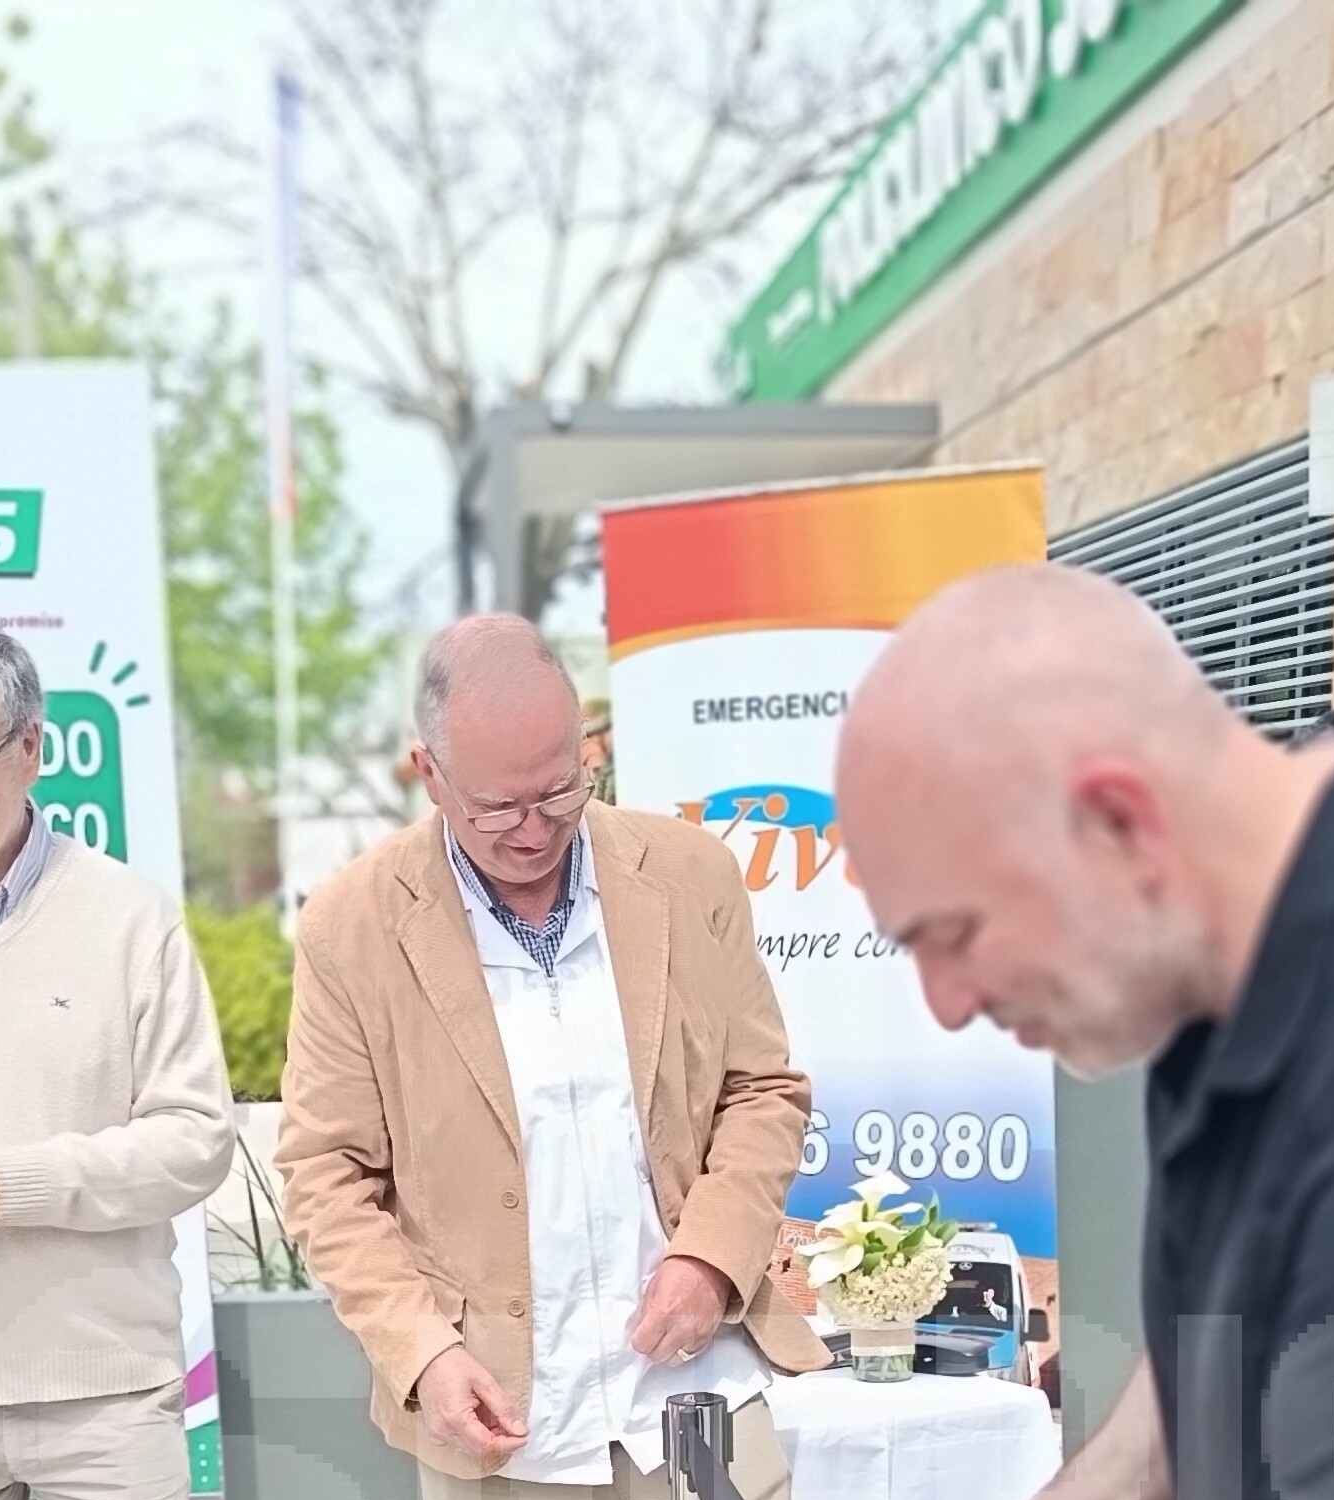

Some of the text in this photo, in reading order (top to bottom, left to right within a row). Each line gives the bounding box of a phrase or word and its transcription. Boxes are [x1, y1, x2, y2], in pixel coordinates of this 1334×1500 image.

[693, 690, 848, 725] EMERGENCI
[757, 932, 841, 973] mpre
[853, 1109, 1029, 1182] 9880
